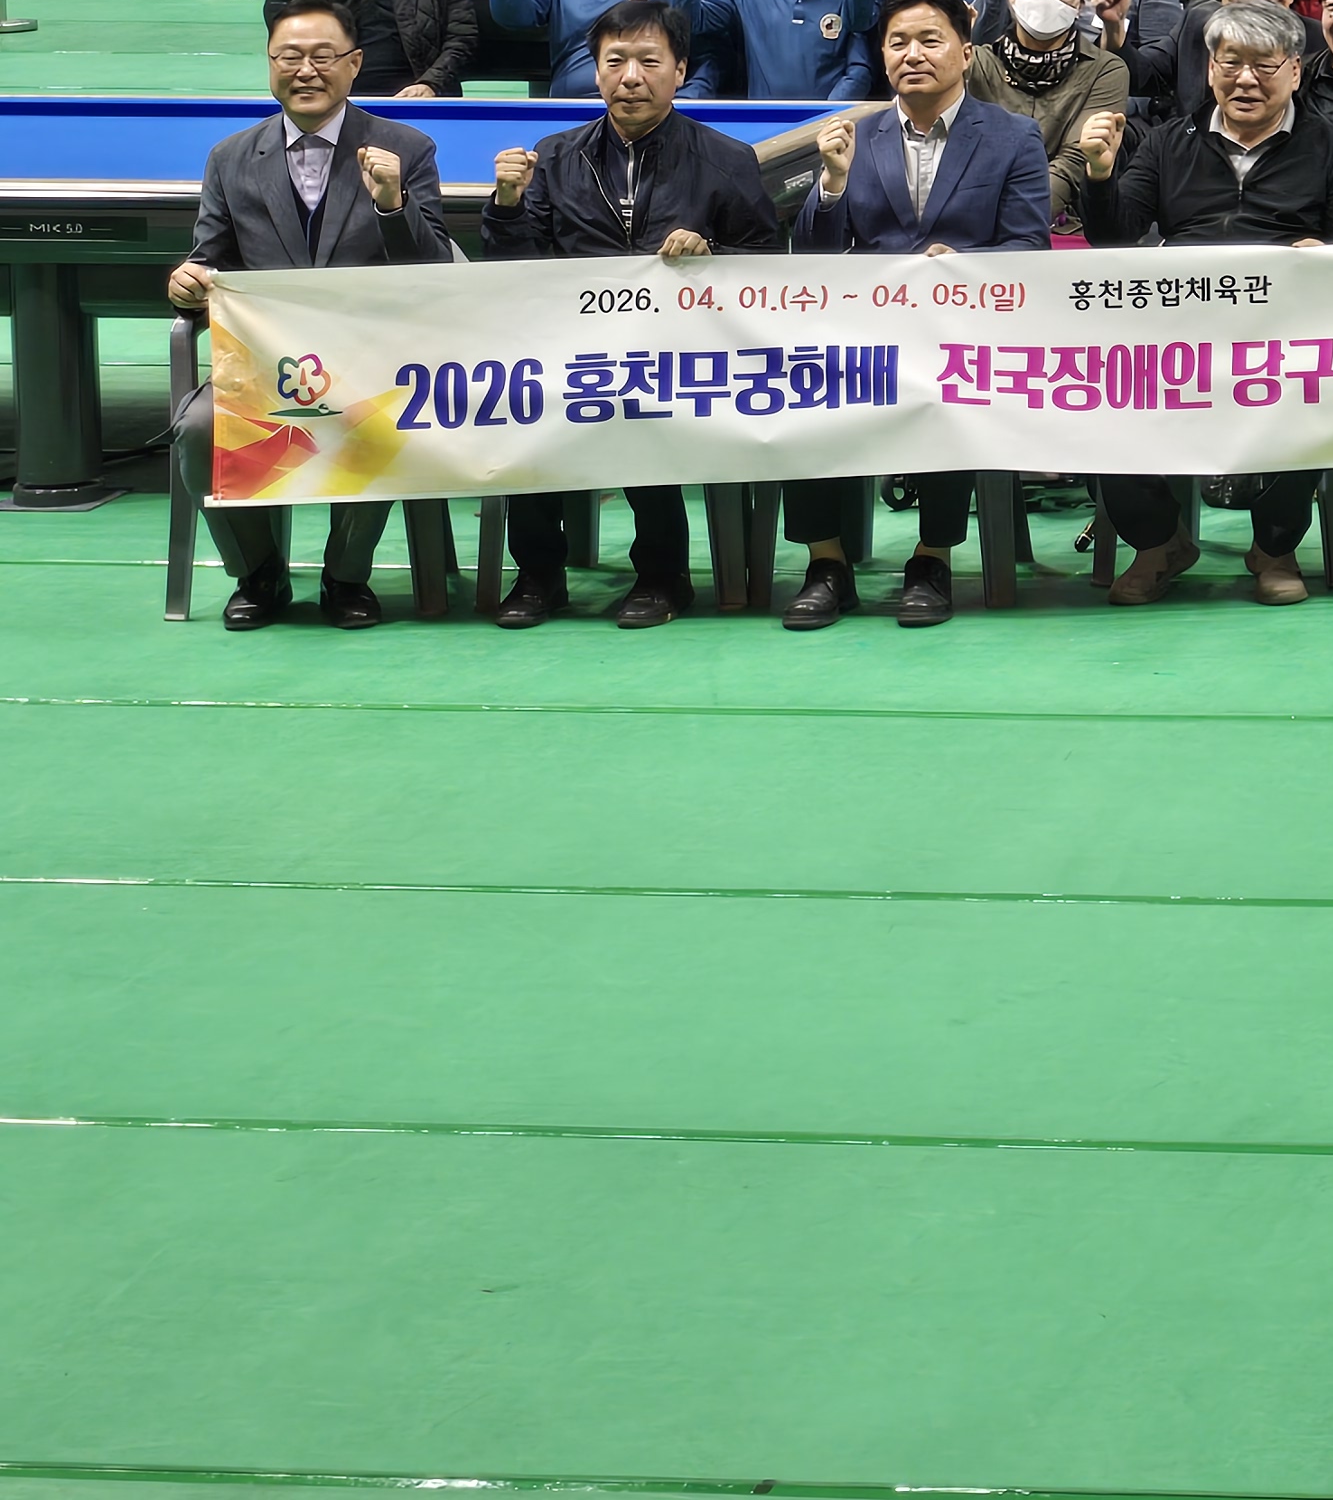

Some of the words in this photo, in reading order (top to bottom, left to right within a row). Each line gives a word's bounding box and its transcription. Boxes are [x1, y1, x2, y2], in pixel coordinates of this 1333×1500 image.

[579, 289, 661, 315] 2026.
[677, 286, 724, 312] 04.
[738, 284, 828, 312] 01.(수)
[872, 283, 918, 310] 04.
[932, 280, 1026, 313] 05.(일)
[1068, 274, 1273, 312] 홍천종합체육관
[394, 358, 545, 431] 2026
[562, 343, 900, 424] 홍천무궁화배
[936, 341, 1213, 412] 전국장애인
